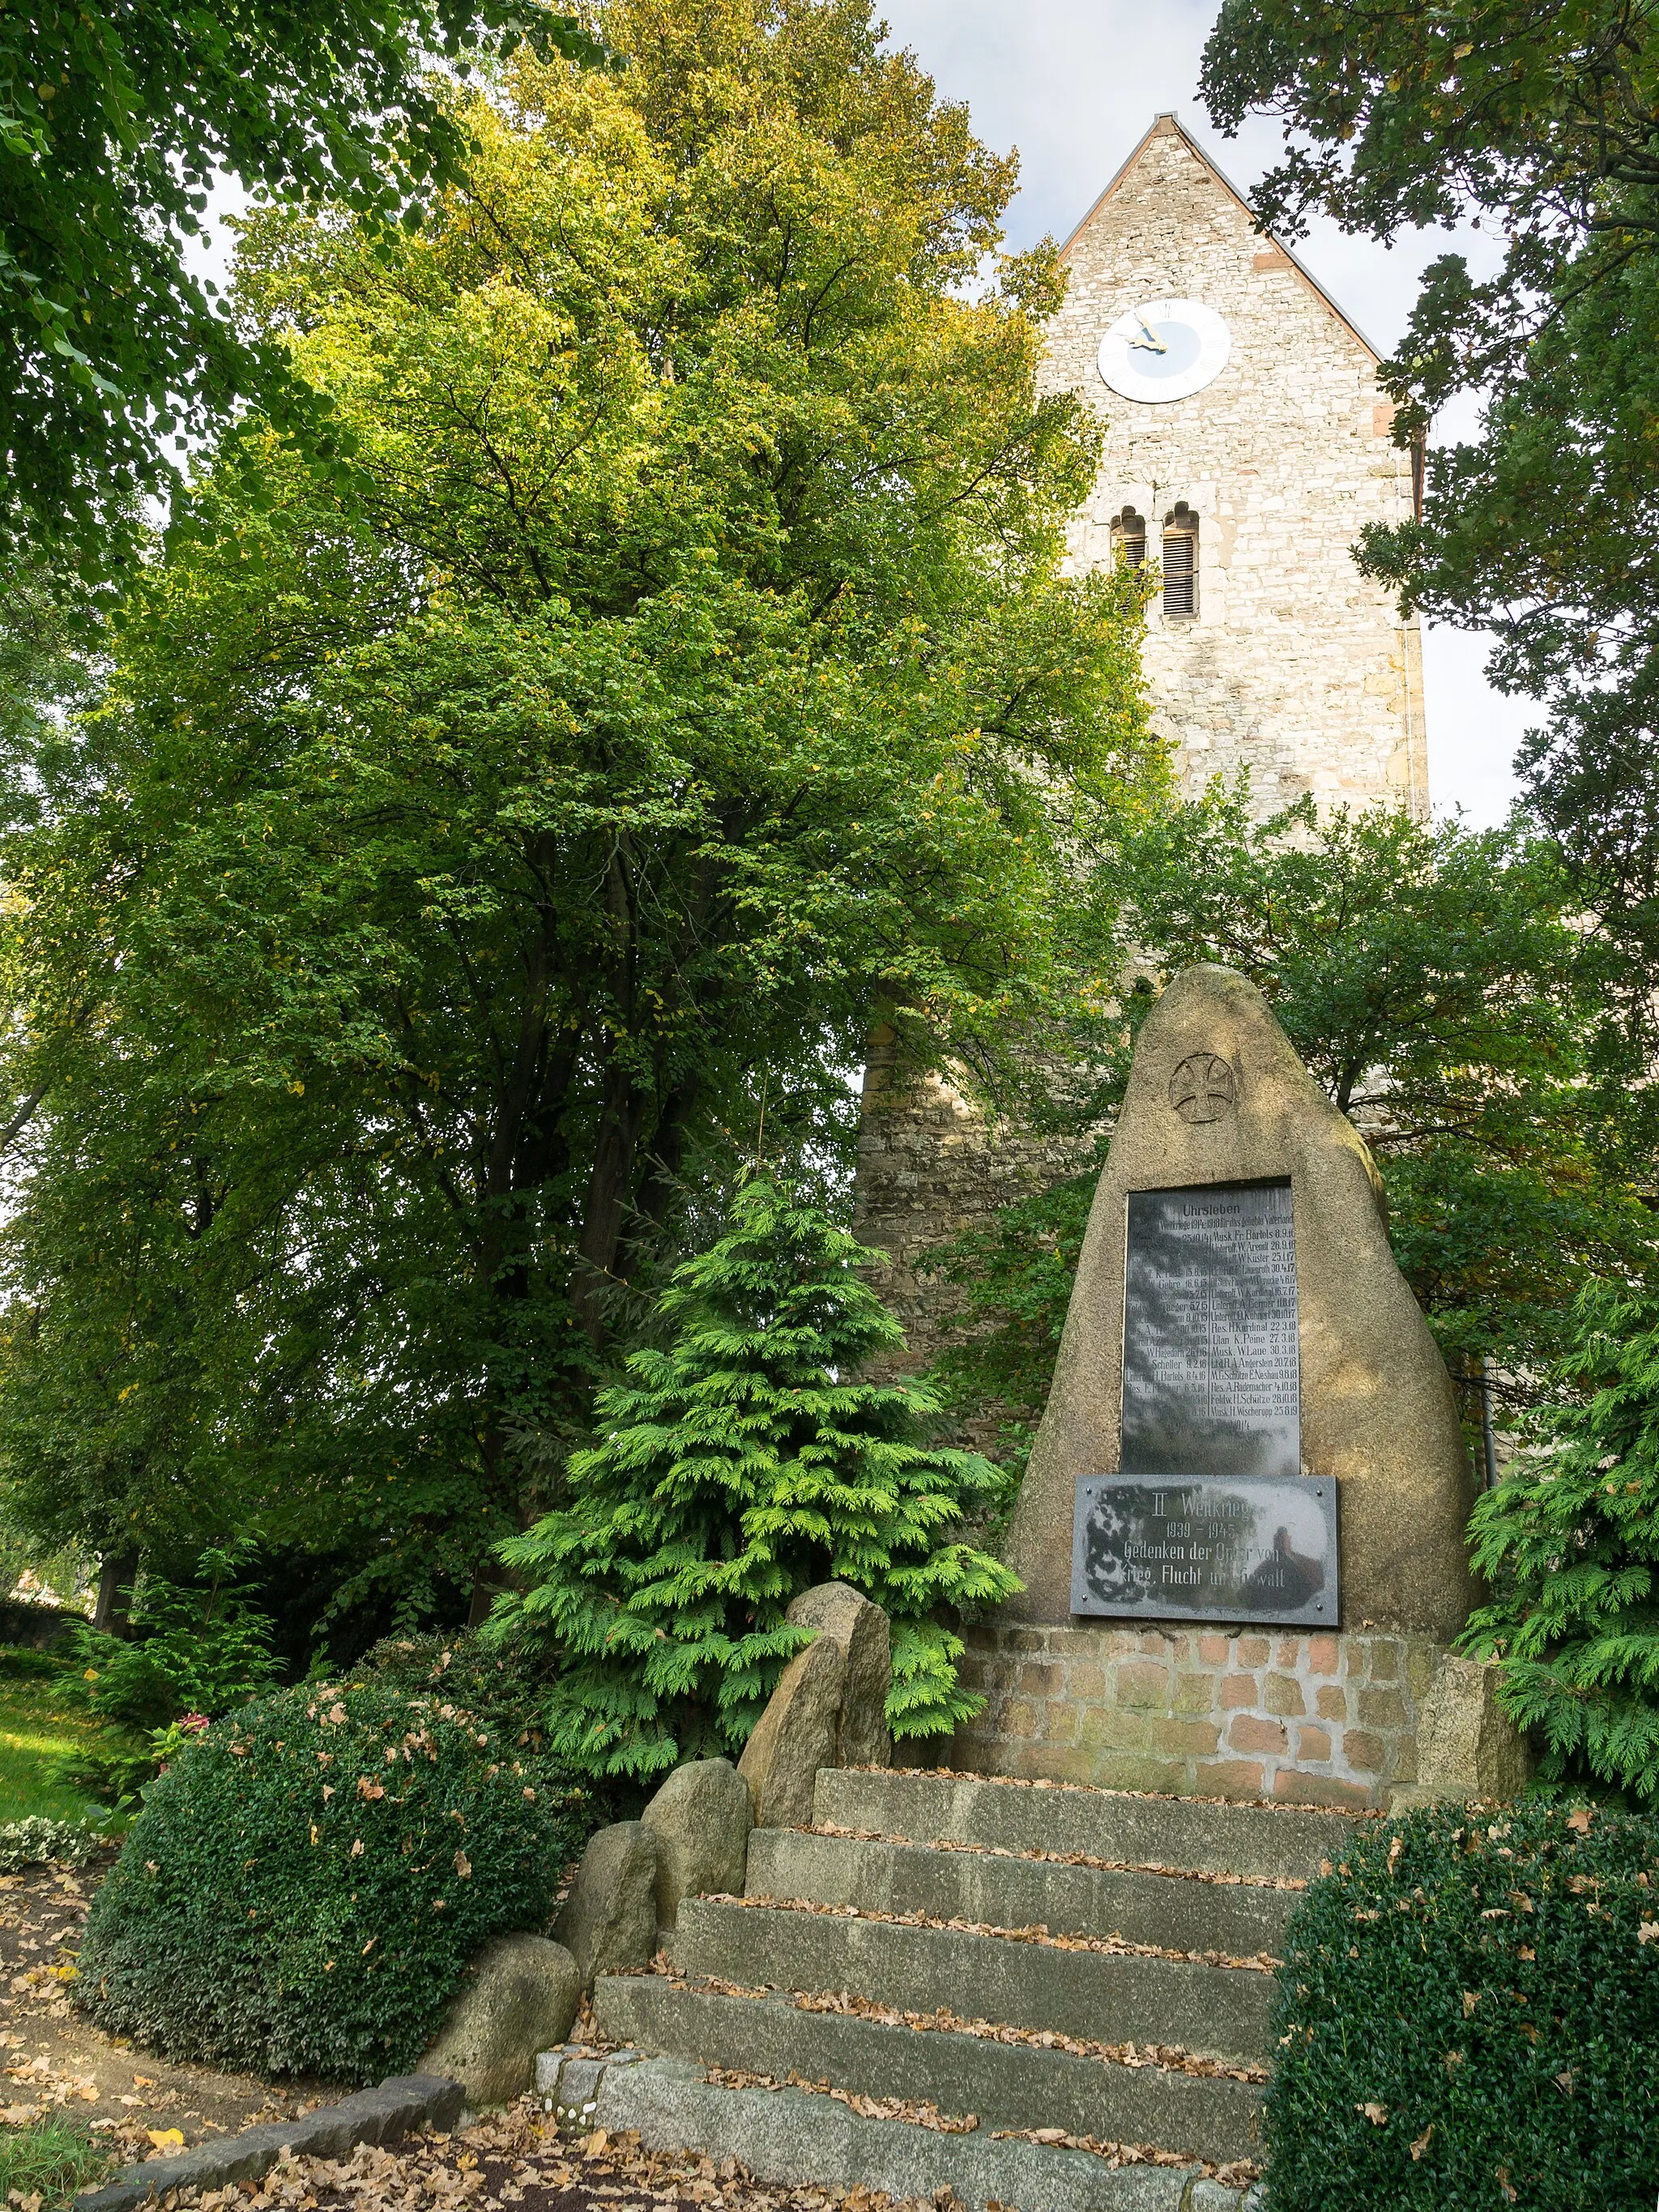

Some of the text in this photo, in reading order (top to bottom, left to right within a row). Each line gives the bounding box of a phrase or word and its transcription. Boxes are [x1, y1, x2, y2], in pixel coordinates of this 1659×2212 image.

[1183, 1204, 1240, 1217] Uhrsleben
[1246, 1229, 1273, 1240] Bartels
[1213, 1334, 1230, 1344] Ulan
[1152, 1359, 1183, 1369] Scheller
[1151, 1492, 1249, 1522] II Weltkrieg
[1166, 1521, 1191, 1538] 1939
[1208, 1522, 1236, 1539] 1945
[1124, 1539, 1185, 1561] Gedenken
[1189, 1540, 1213, 1561] der
[1256, 1547, 1280, 1562] von
[1161, 1565, 1202, 1585] Flucht
